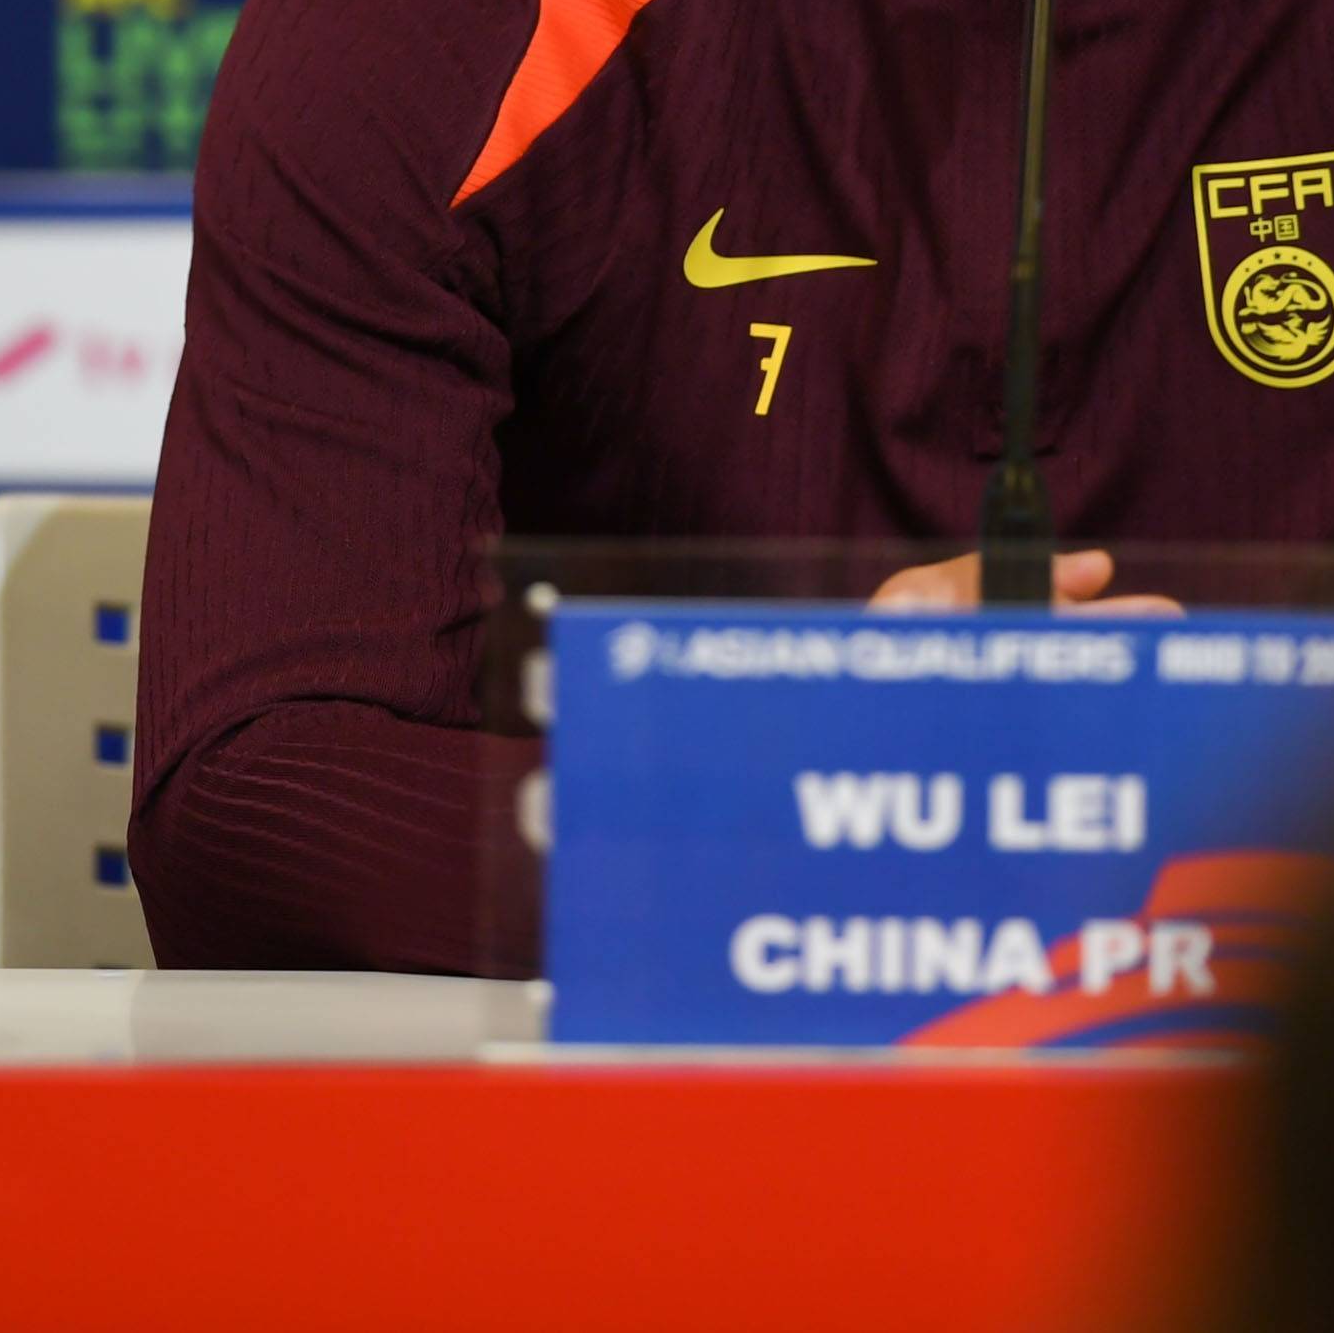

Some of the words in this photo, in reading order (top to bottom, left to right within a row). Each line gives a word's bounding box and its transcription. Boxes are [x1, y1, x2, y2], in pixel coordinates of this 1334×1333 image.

[1208, 169, 1334, 220] CFA
[1249, 213, 1299, 243] 中国
[749, 323, 793, 415] 7
[797, 771, 963, 852] WU
[987, 773, 1147, 853] LEI
[729, 916, 1052, 996] CHINA
[1079, 920, 1217, 998] PR
